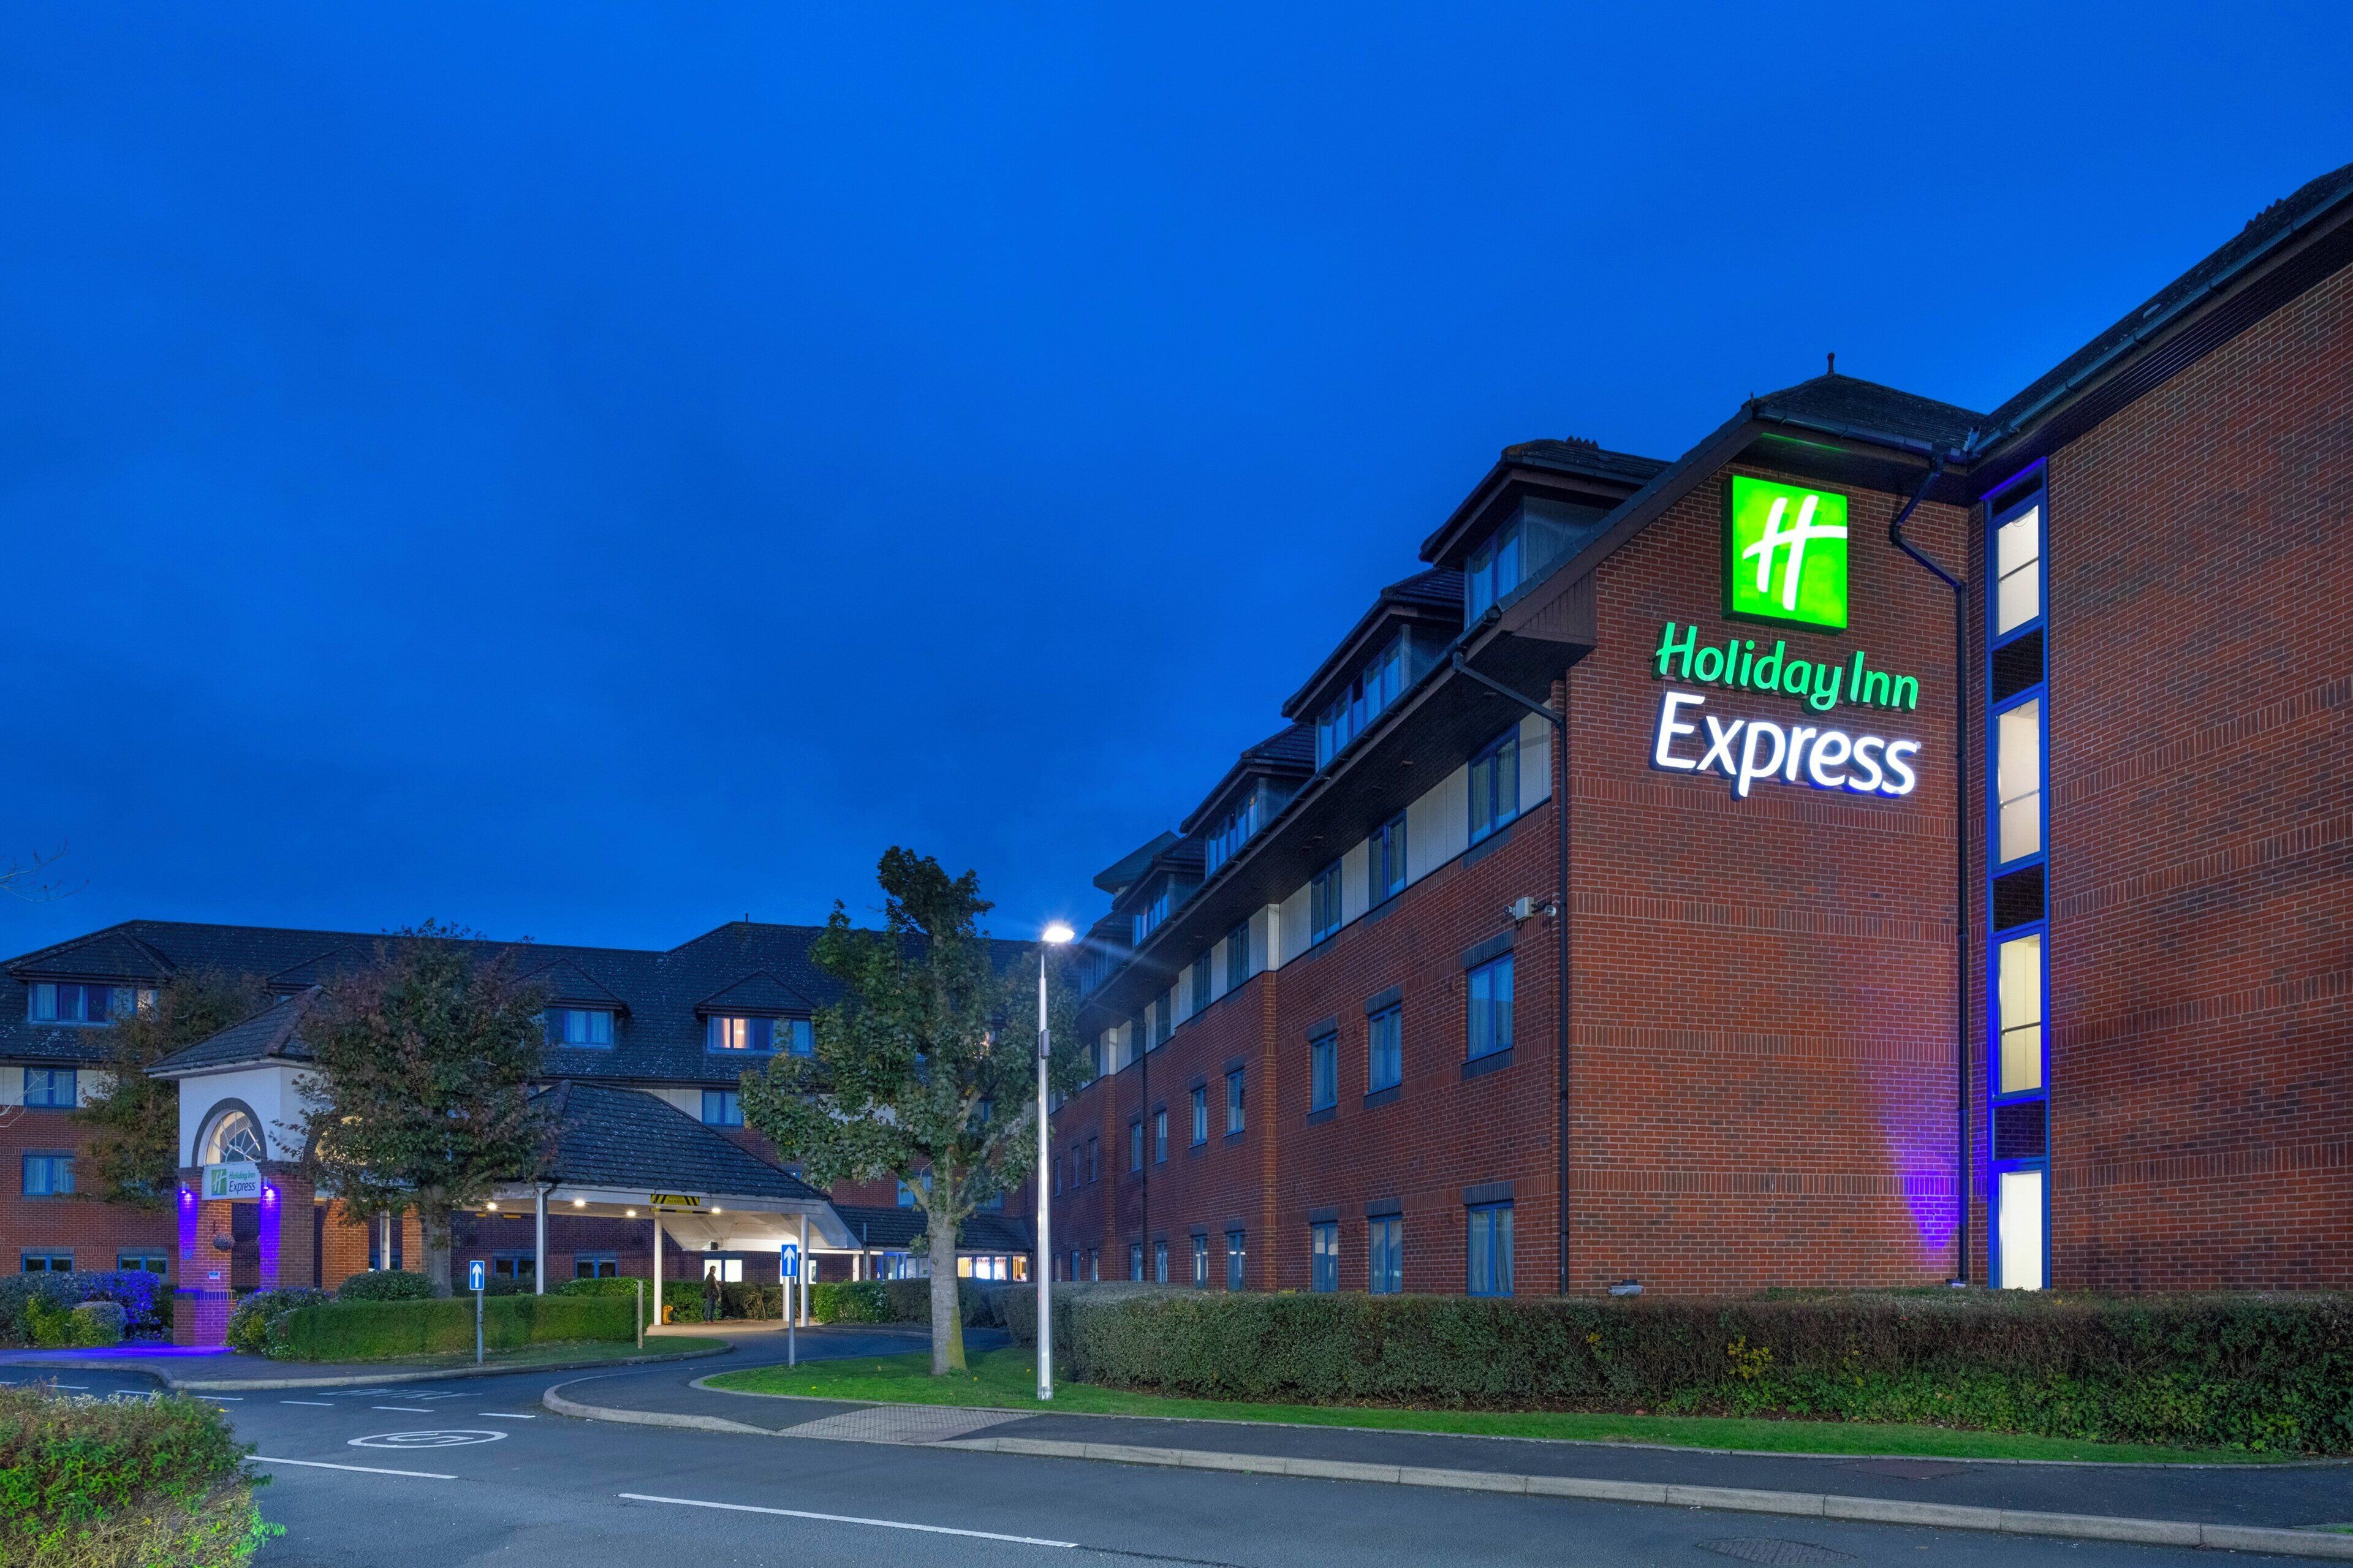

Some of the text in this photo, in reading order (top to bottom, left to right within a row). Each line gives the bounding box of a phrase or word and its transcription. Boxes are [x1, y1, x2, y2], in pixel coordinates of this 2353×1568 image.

[1656, 622, 1919, 710] Holiday Inn
[1656, 692, 1917, 797] Express
[229, 1172, 248, 1180] Holiday
[229, 1181, 255, 1194] Express
